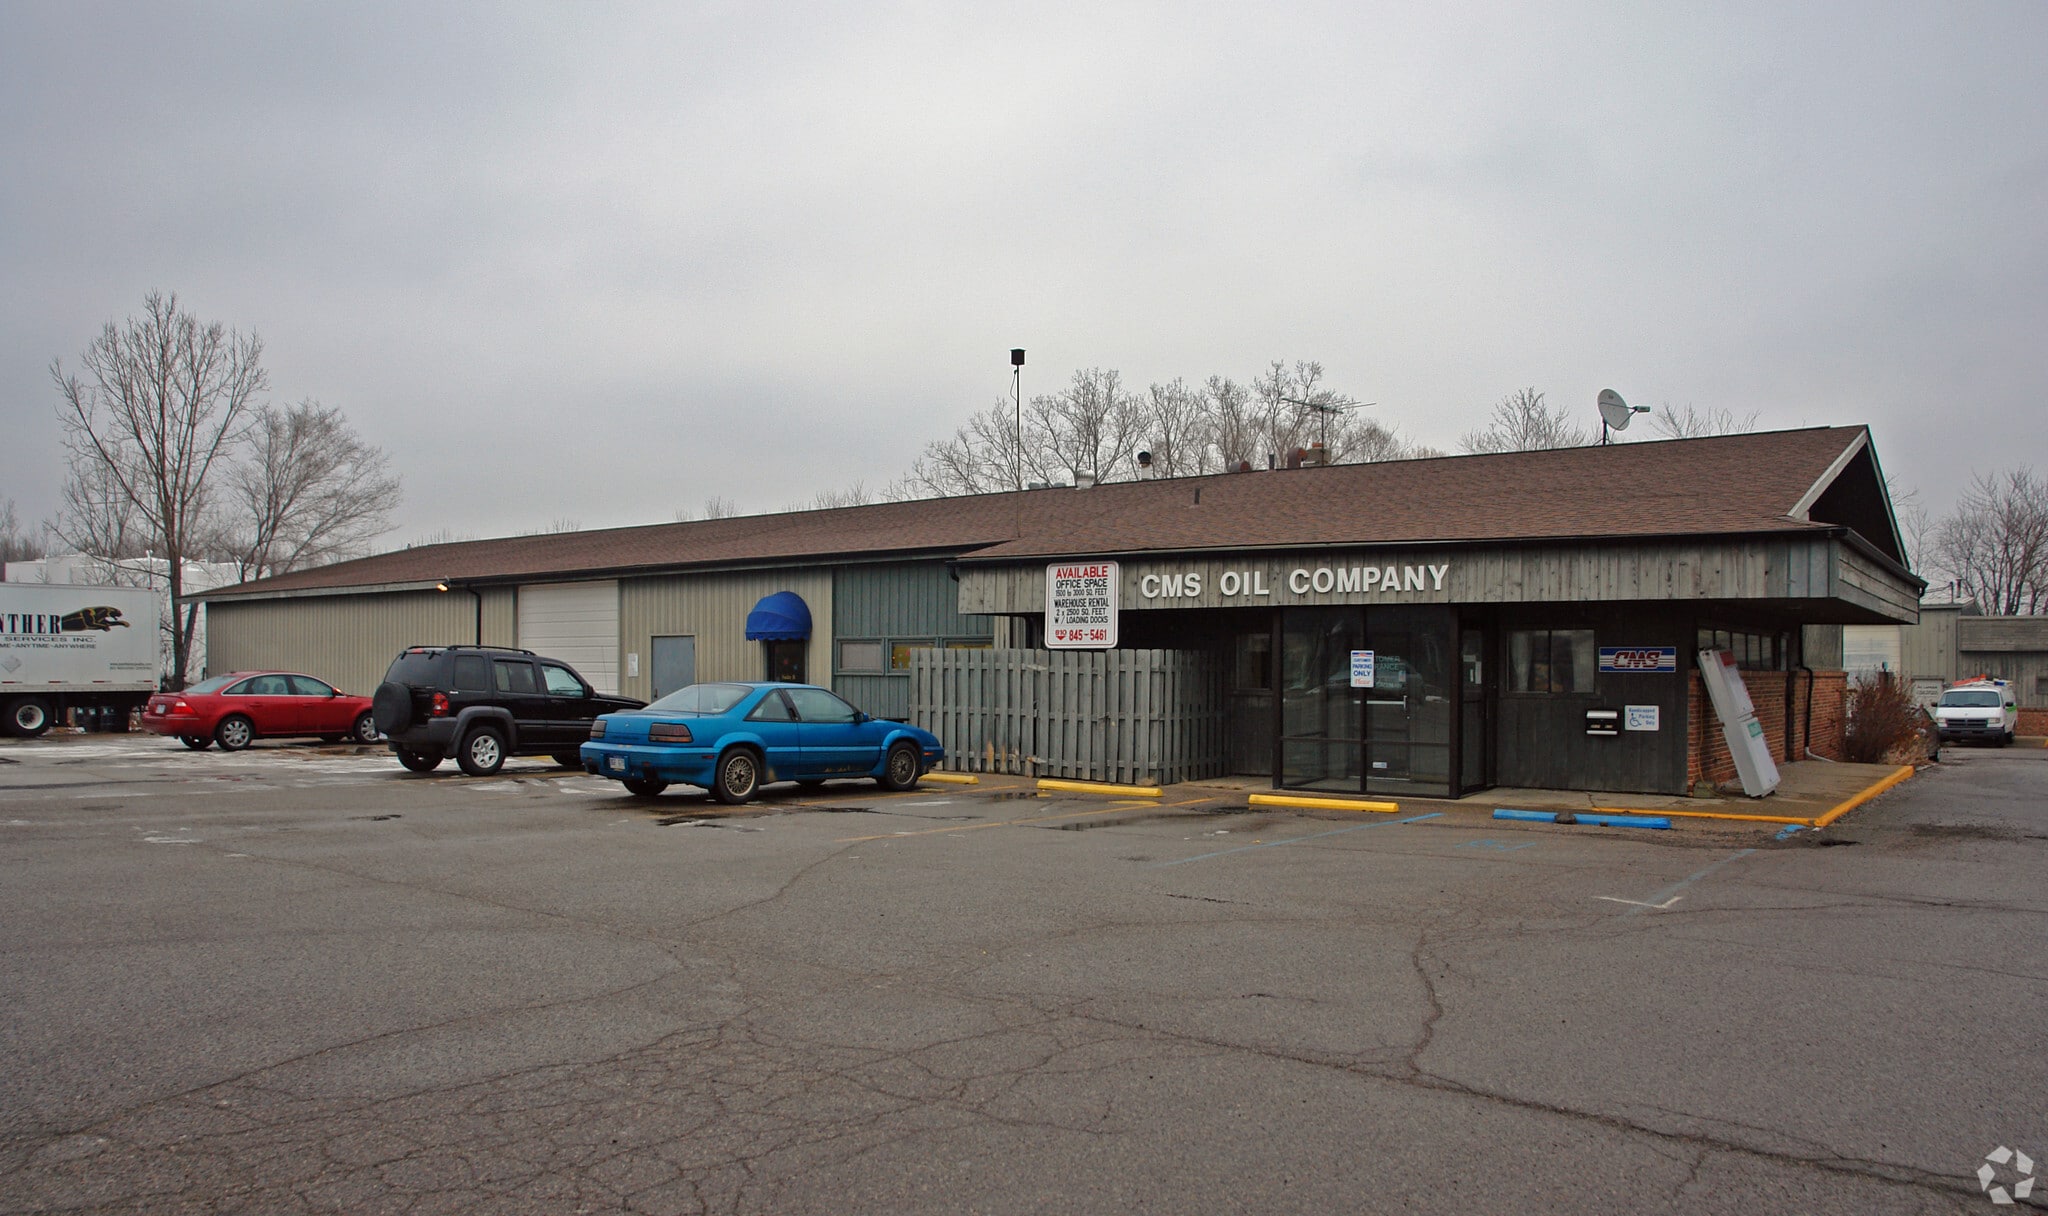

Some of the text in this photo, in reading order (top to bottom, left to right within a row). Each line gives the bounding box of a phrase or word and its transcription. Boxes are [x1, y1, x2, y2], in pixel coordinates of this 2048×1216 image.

[1056, 566, 1109, 579] AVAILABLE
[1056, 578, 1108, 589] OFFICE SPACE
[1141, 564, 1449, 598] CMS OIL COMPANY
[1095, 588, 1107, 596] FEET
[1054, 598, 1109, 608] WAREHOUSE RENTAL
[1066, 616, 1089, 624] LOADING
[1090, 615, 1108, 624] DOCKS
[1613, 651, 1662, 669] CMS
